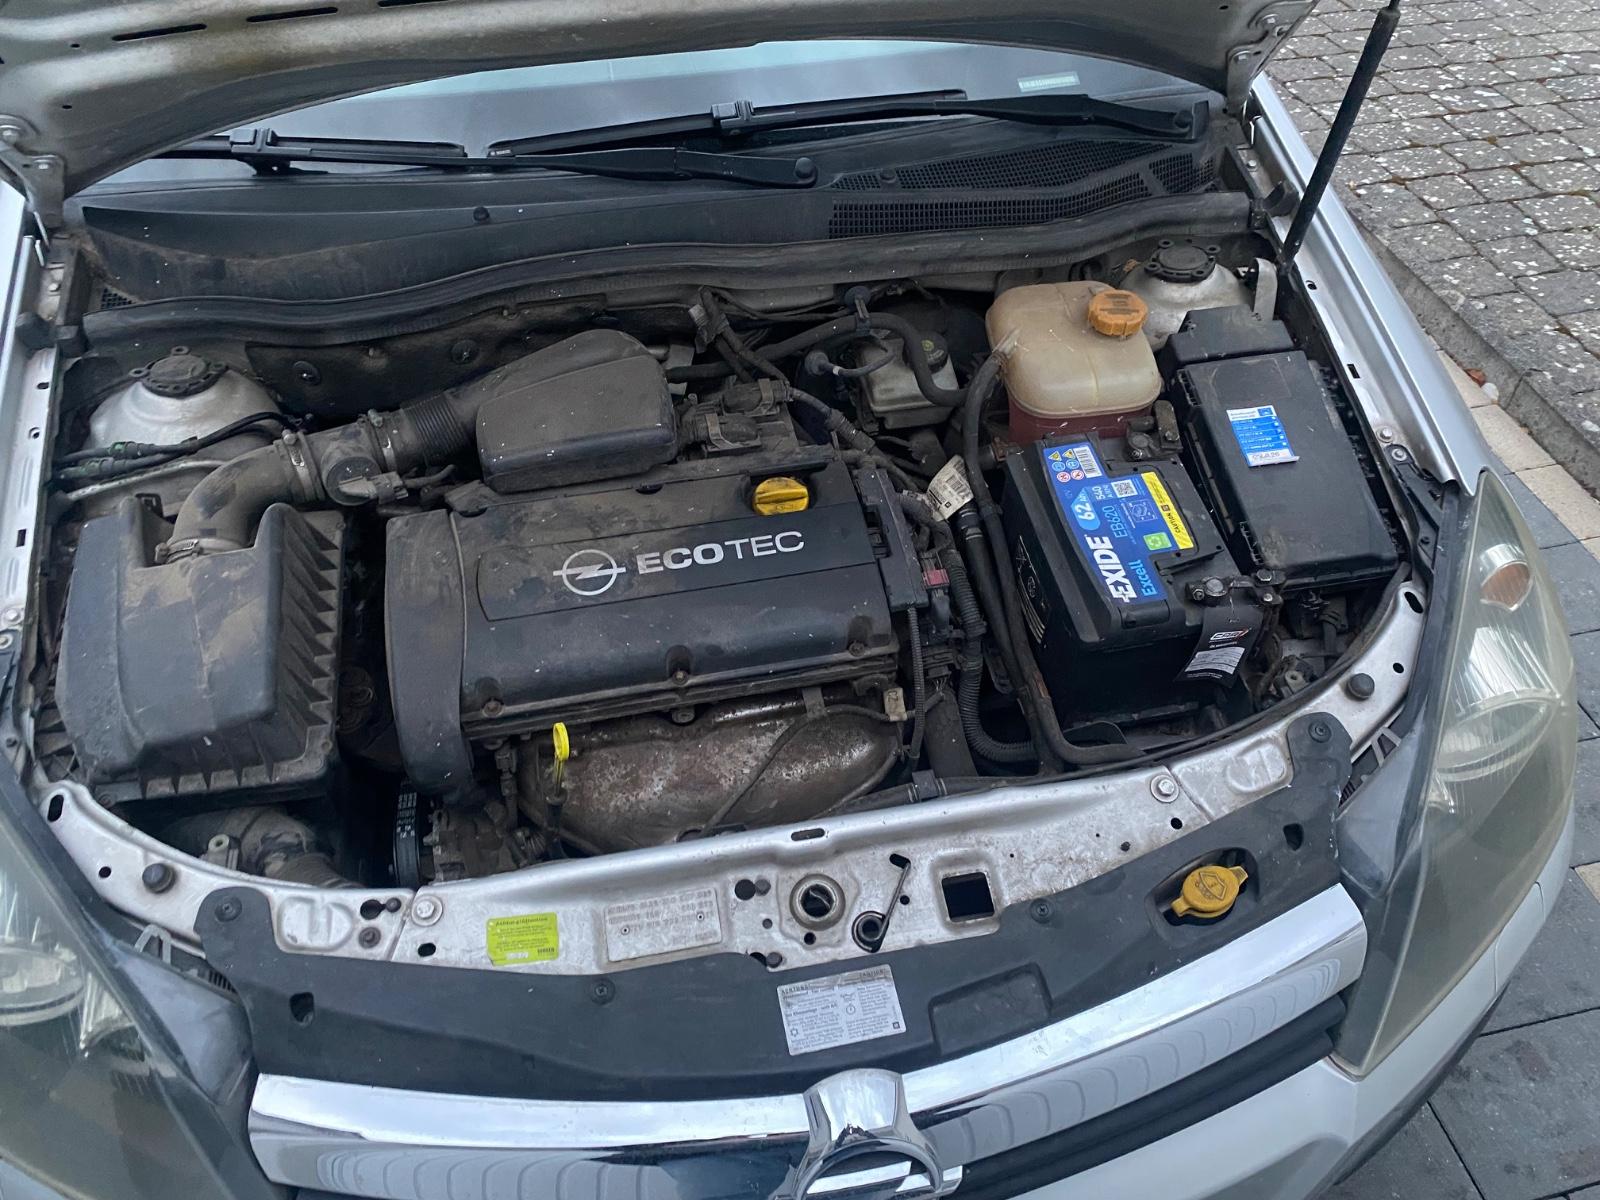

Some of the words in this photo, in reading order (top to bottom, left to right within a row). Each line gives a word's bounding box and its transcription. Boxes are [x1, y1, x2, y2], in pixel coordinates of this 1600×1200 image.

[1092, 486, 1106, 500] 540
[1074, 502, 1096, 520] 62
[1102, 505, 1128, 538] EB620
[1167, 512, 1181, 533] CAUTION
[636, 531, 805, 575] ECOTEC
[1085, 536, 1138, 602] EXIDE
[1128, 560, 1158, 597] Excell
